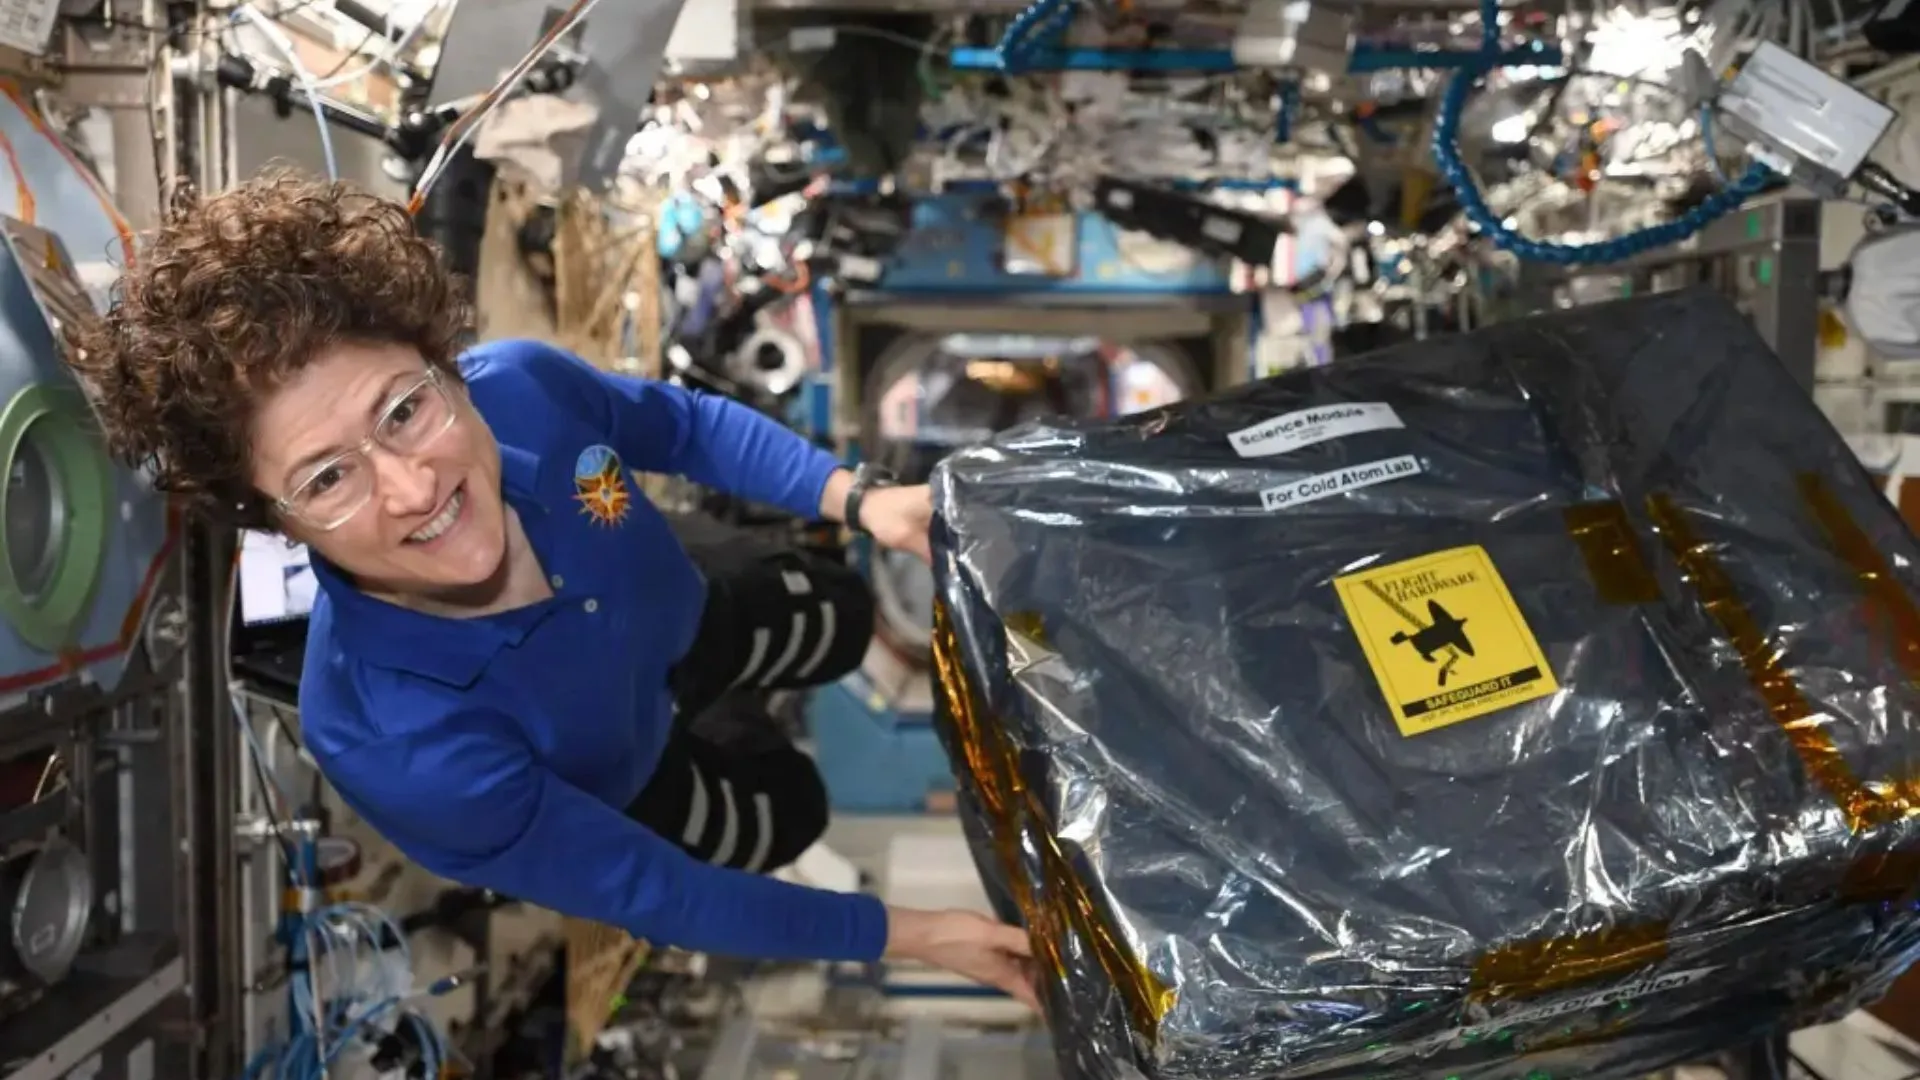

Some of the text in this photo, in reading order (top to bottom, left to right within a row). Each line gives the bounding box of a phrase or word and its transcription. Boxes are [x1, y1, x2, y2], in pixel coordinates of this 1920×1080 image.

[1239, 418, 1303, 445] Science
[1306, 407, 1364, 424] Module
[1267, 461, 1414, 506] For Cold Atom Lab
[1383, 568, 1439, 594] FLIGHT
[1396, 571, 1478, 602] HARDWARE
[1425, 675, 1513, 710] SAFEGUARD IT
[1562, 975, 1690, 1010] Direction
